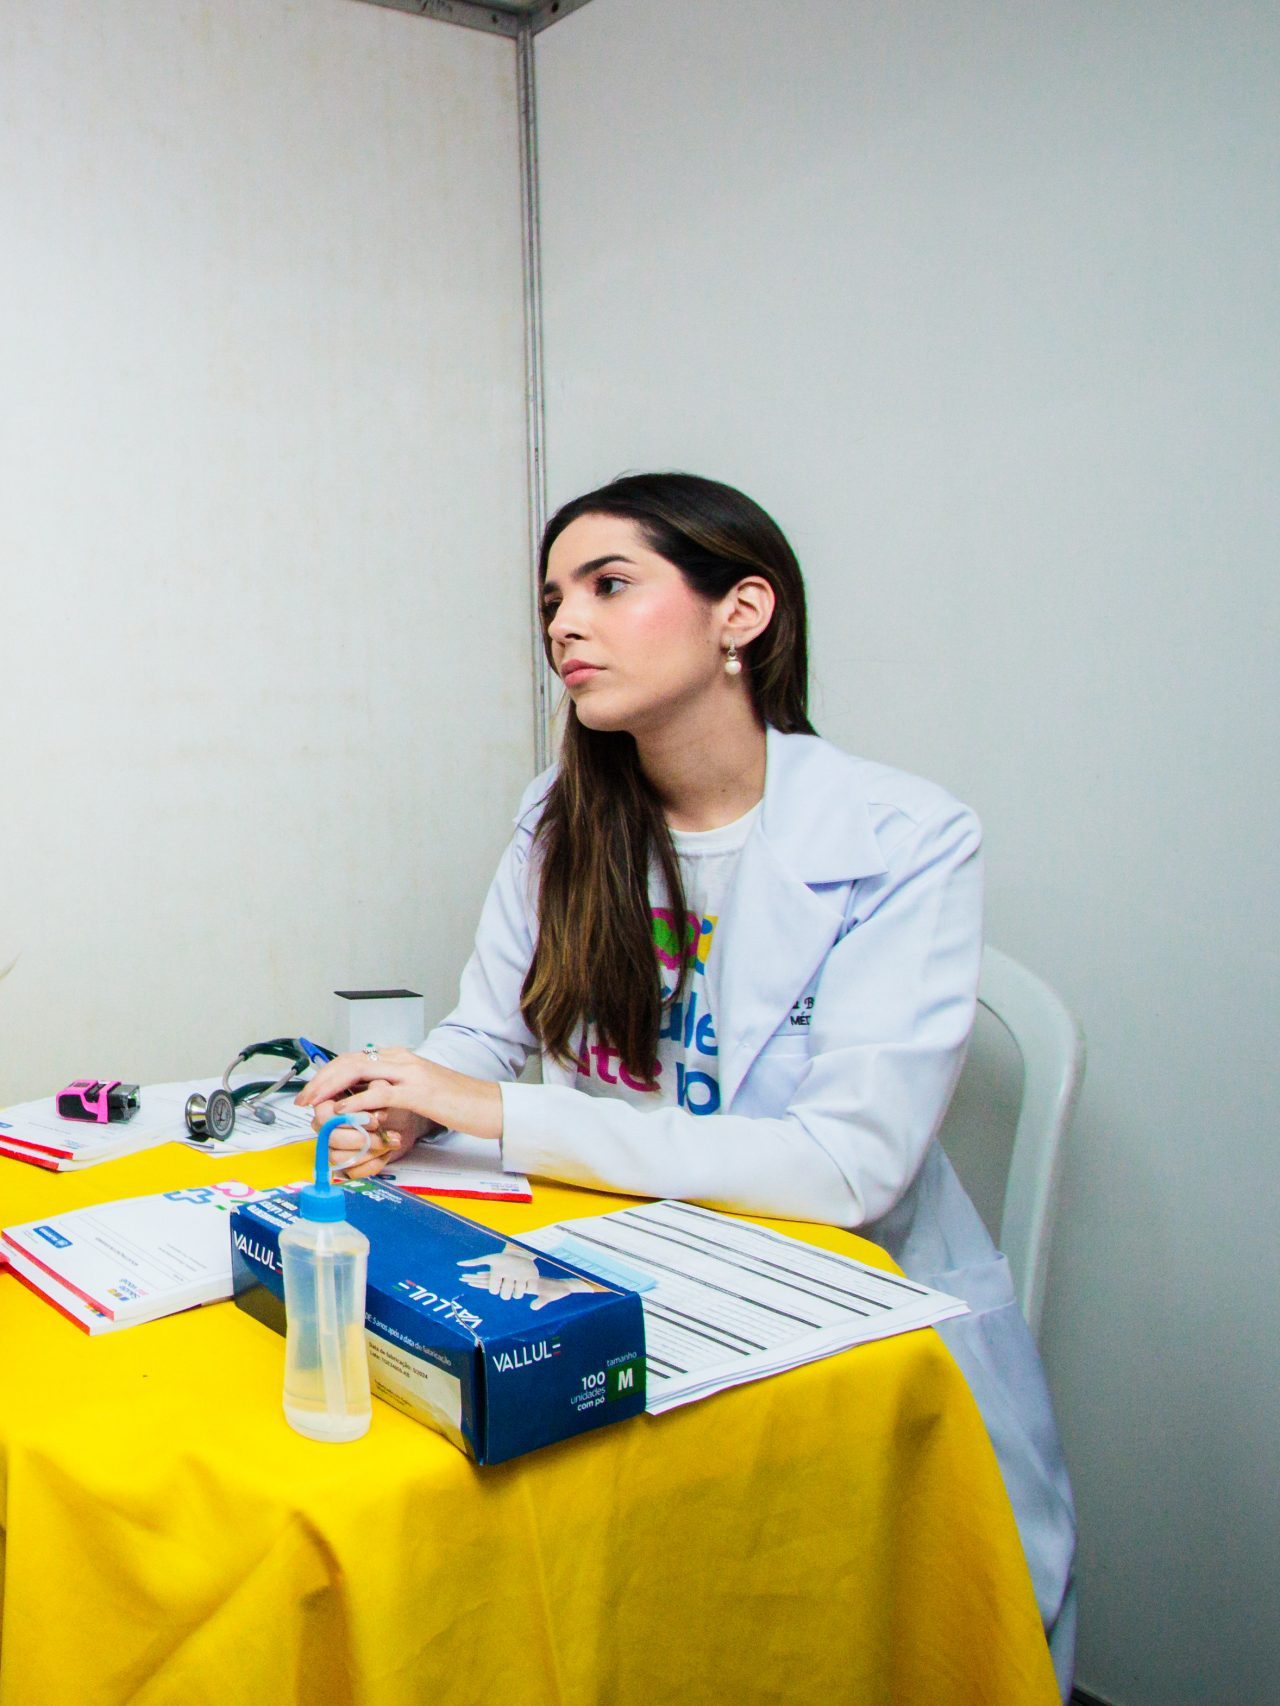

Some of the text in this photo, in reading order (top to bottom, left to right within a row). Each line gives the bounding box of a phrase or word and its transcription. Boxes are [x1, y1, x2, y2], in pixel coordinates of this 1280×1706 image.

[607, 1351, 638, 1367] tamanho
[581, 1371, 606, 1391] 100
[618, 1368, 634, 1391] M
[570, 1386, 606, 1405] unidades
[577, 1396, 606, 1411] com pó
